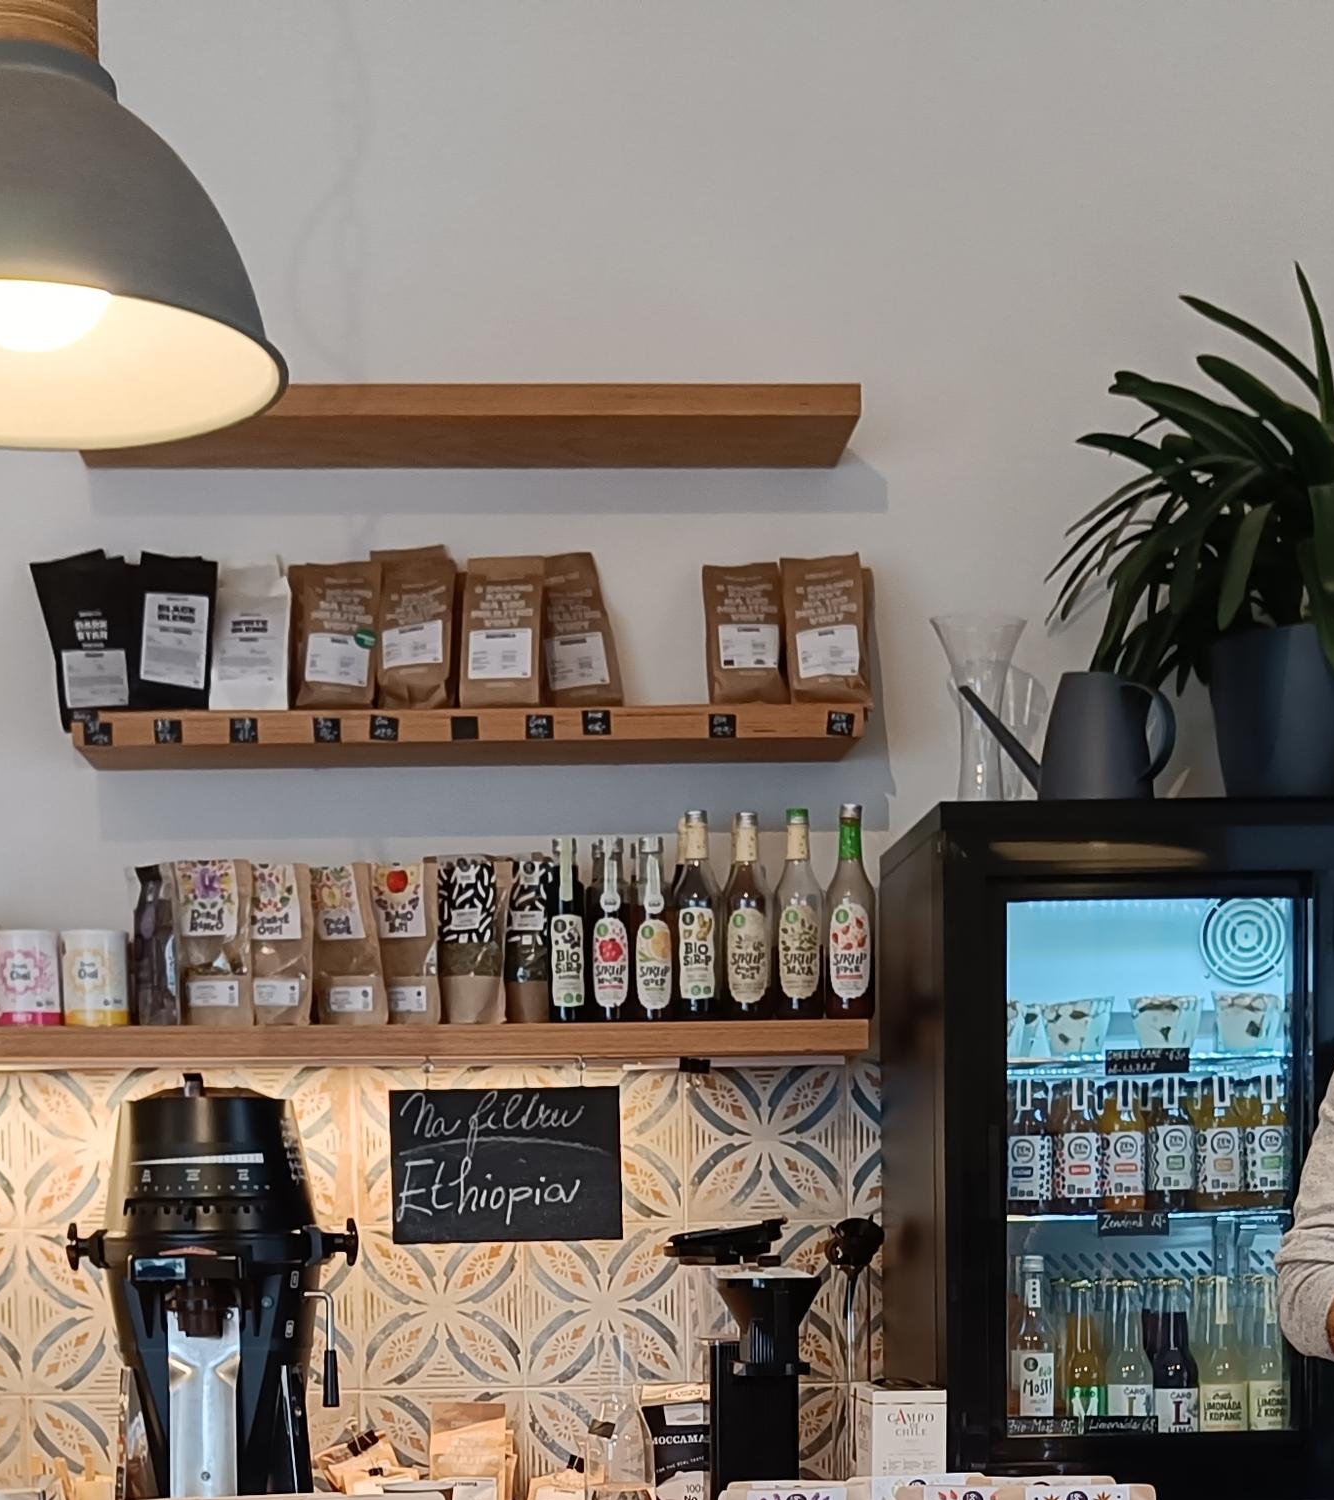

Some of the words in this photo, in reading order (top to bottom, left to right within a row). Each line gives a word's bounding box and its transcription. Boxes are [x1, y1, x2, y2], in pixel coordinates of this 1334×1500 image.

[684, 942, 709, 955] BIO
[400, 1092, 461, 1138] Na
[396, 1155, 581, 1226] Ethiopia
[1203, 1400, 1242, 1411] LIMONÁDA
[887, 1408, 934, 1425] CAMPO
